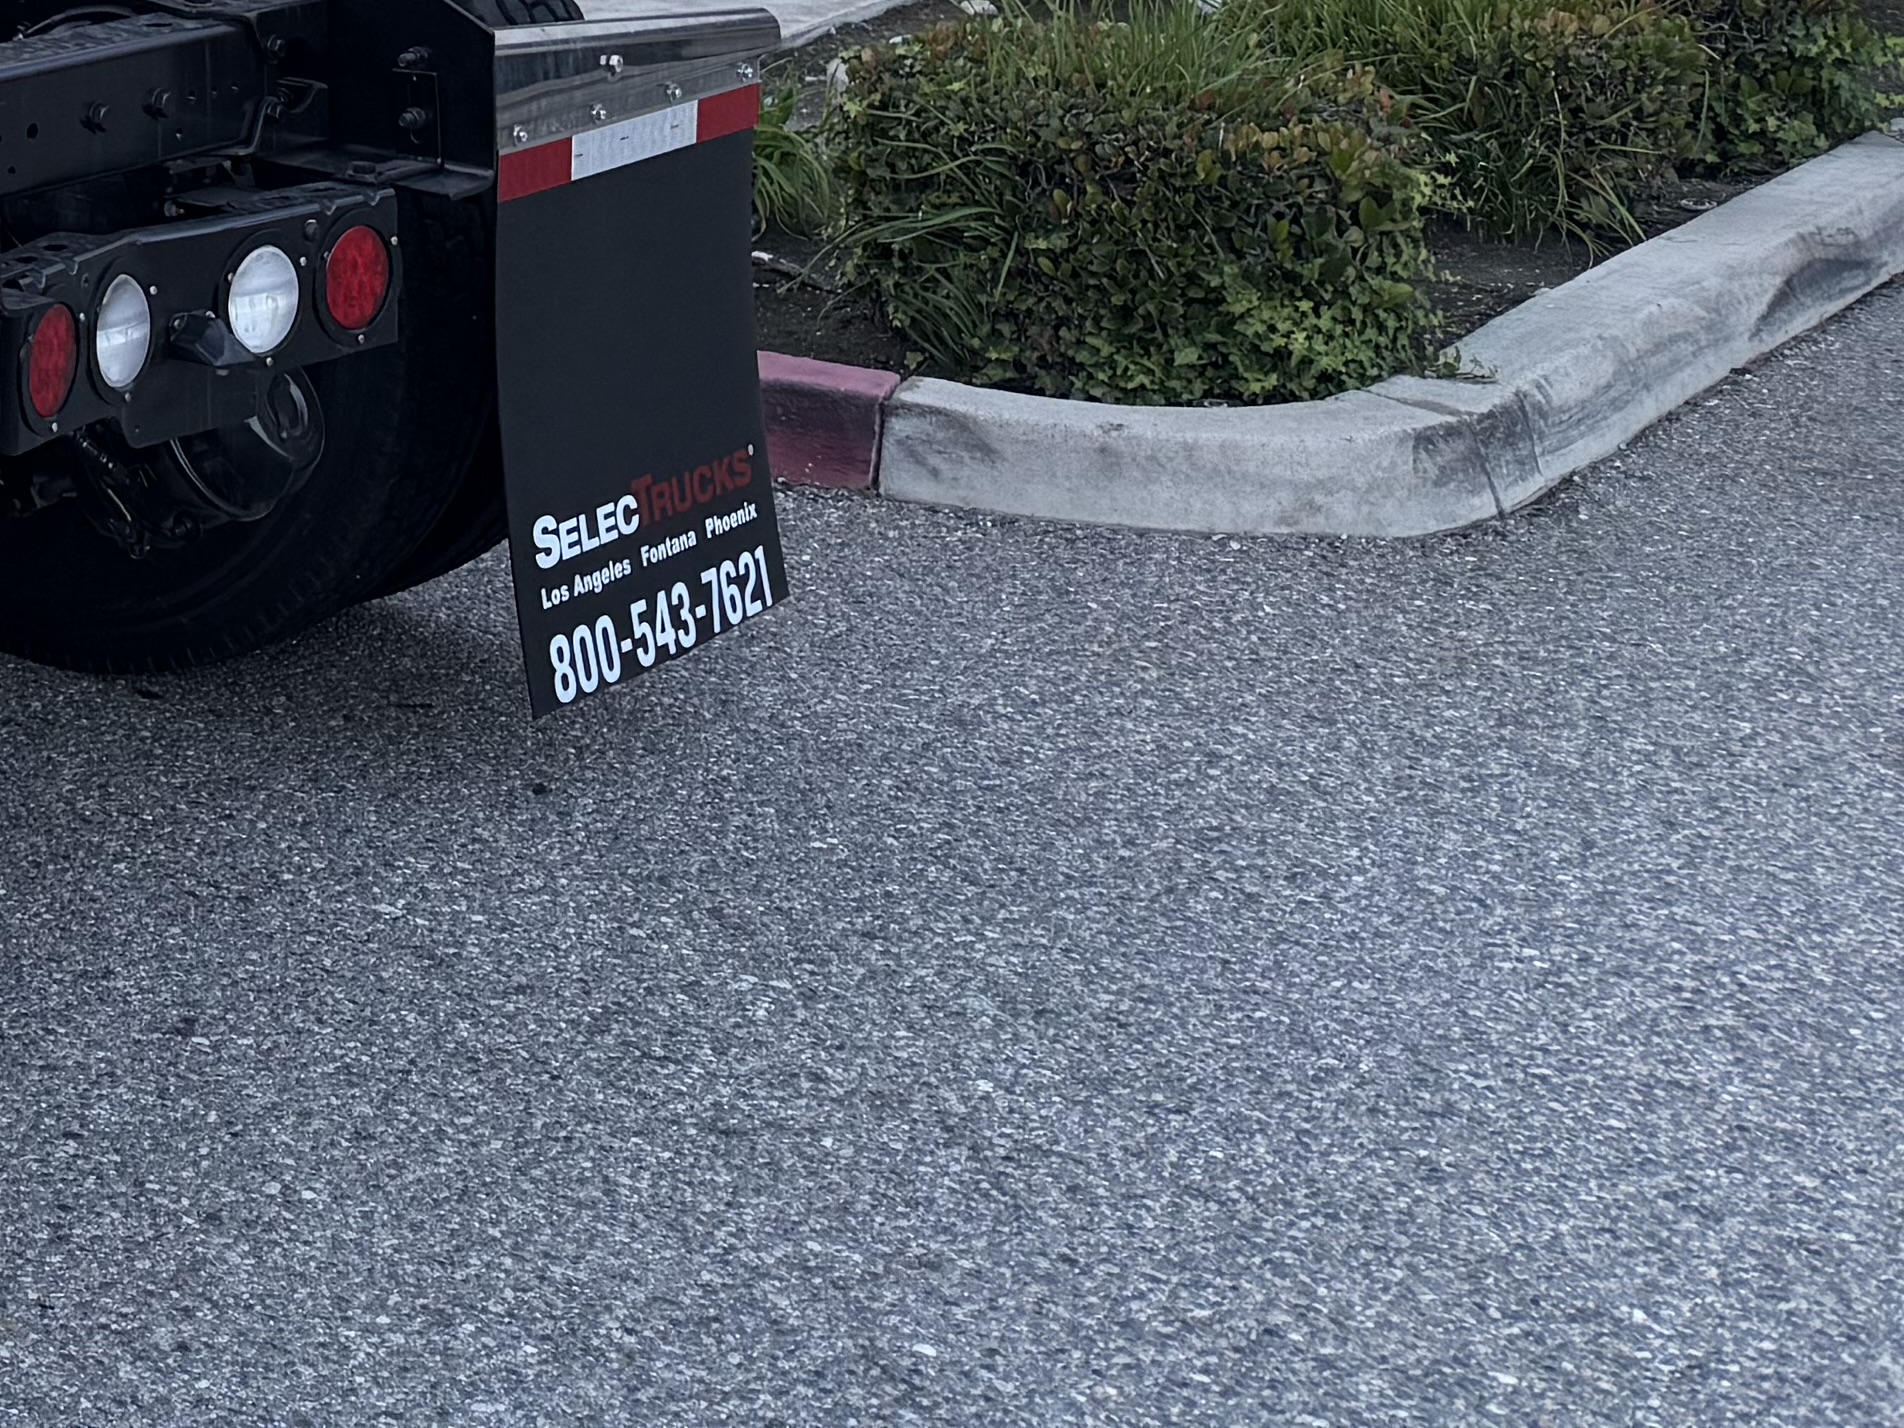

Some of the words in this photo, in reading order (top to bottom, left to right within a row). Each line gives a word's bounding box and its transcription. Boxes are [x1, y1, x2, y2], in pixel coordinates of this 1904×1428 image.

[541, 583, 570, 610] Los
[573, 558, 632, 597] Angeles
[640, 530, 697, 568] Fontana
[704, 501, 758, 539] Phoenix
[549, 545, 773, 704] 800-543-7621
